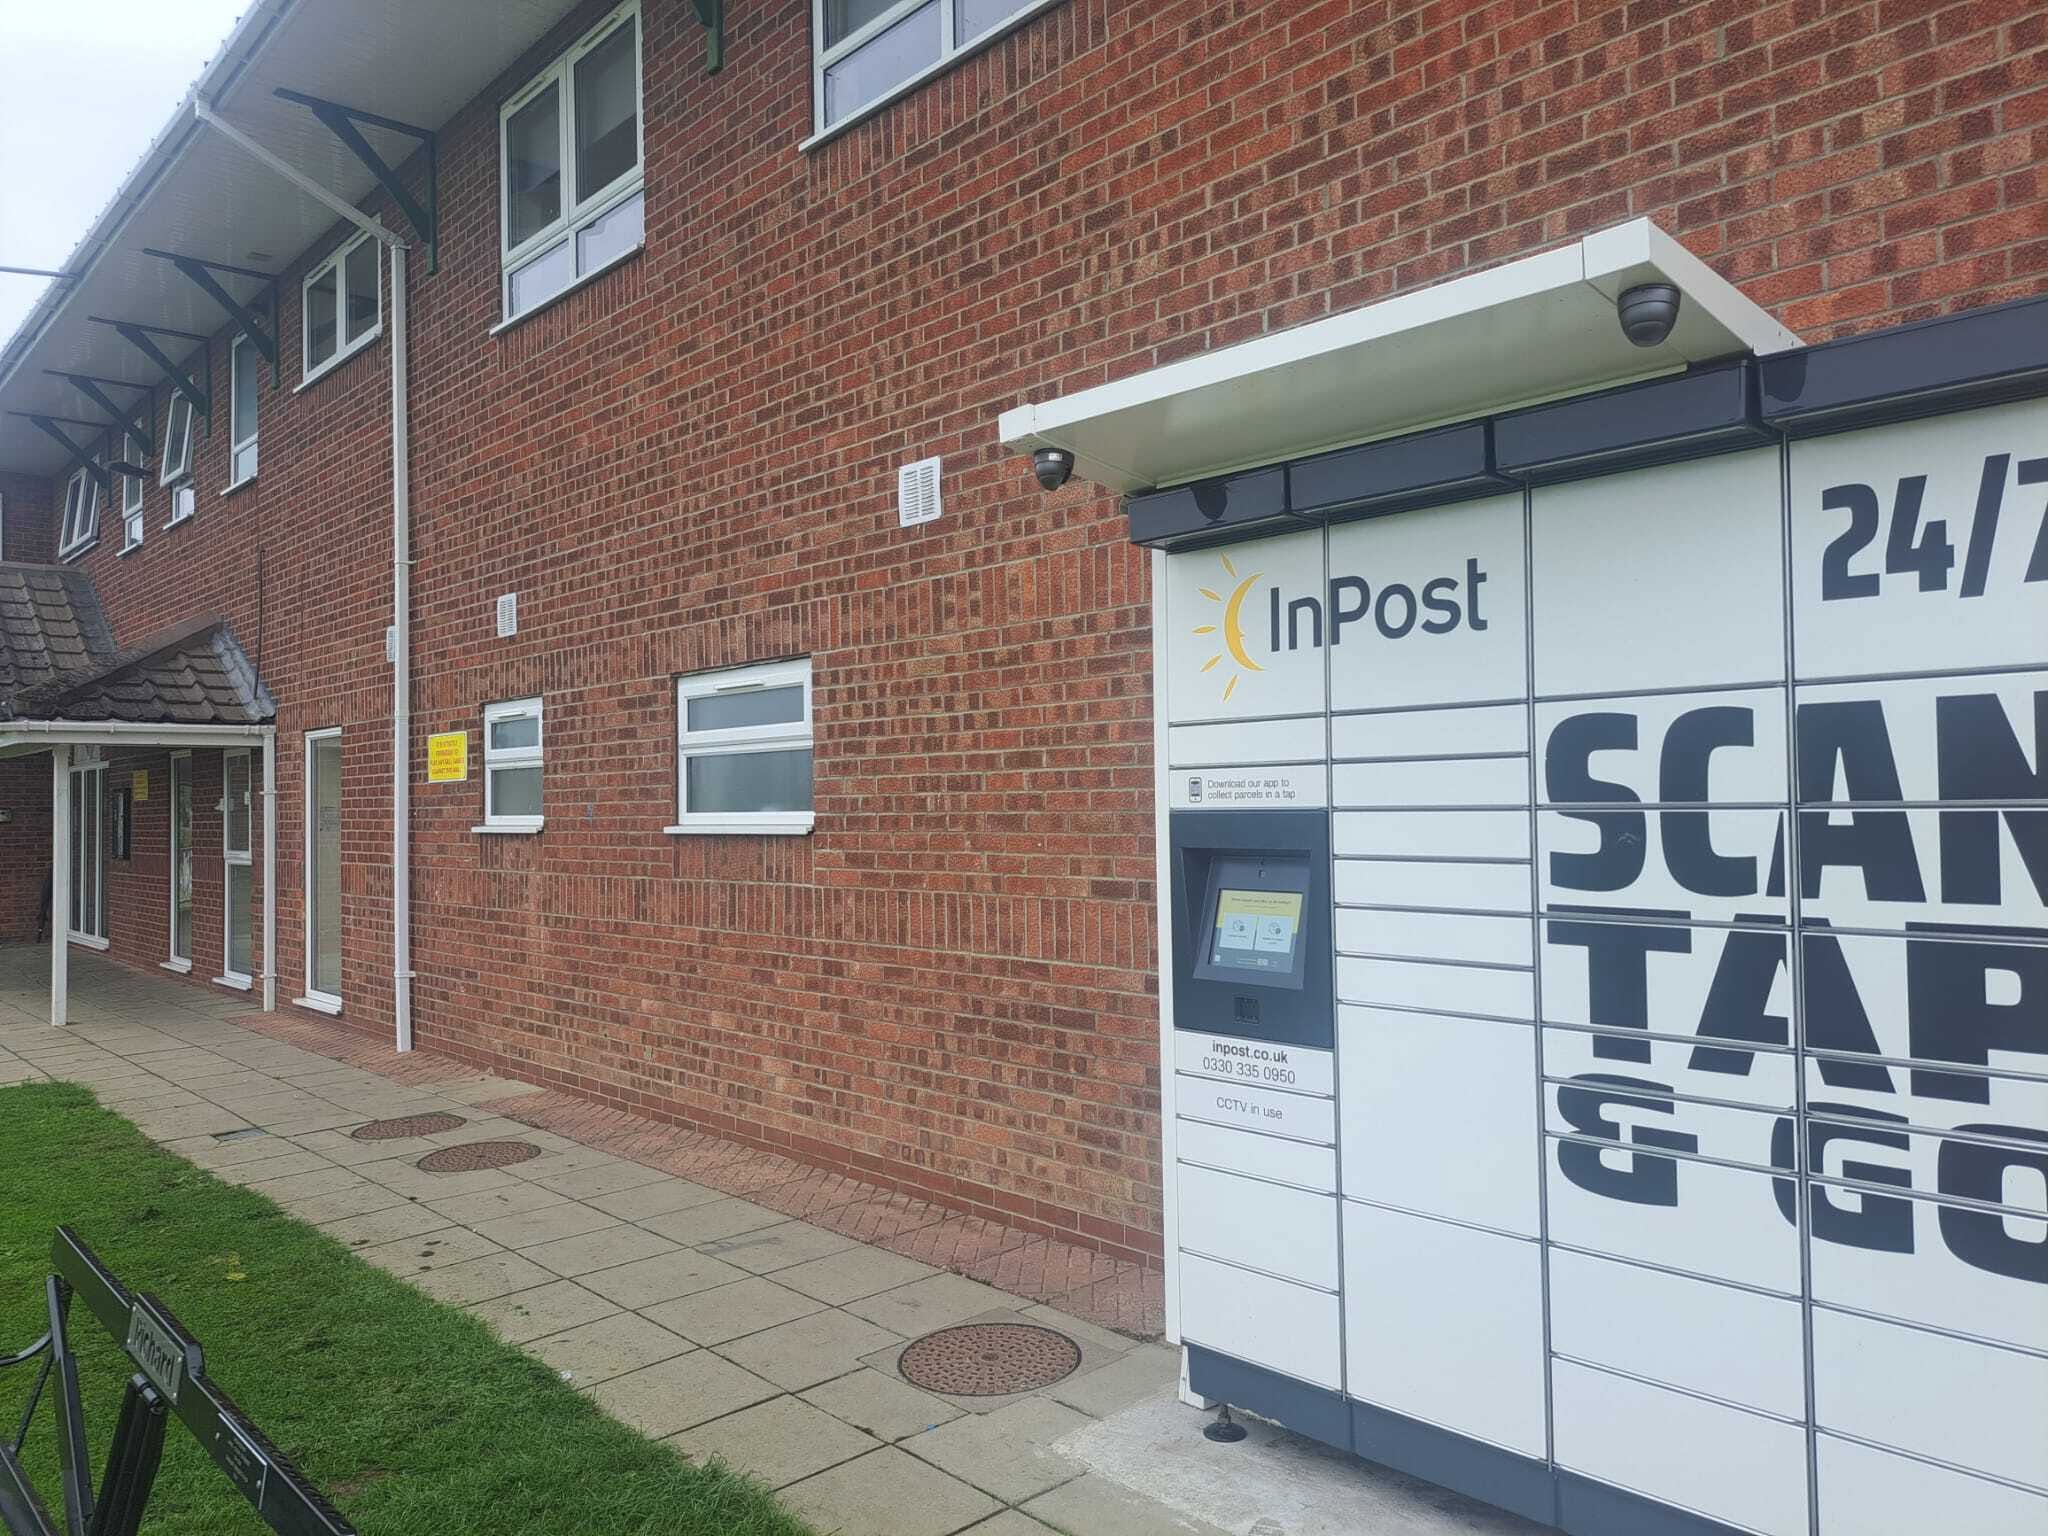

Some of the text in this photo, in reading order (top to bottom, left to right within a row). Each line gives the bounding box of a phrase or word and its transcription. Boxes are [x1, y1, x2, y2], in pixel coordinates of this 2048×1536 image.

[1270, 557, 1488, 653] InPost
[1207, 778, 1290, 789] Download our app to
[1207, 790, 1232, 800] collect
[1234, 790, 1263, 800] parcels
[1265, 790, 1273, 799] in
[1282, 789, 1296, 800] tap
[1545, 690, 2048, 910] SCAN
[1547, 904, 2048, 1110] TAP
[1203, 1056, 1296, 1085] 0330 335 0950
[1212, 1039, 1289, 1064] inpost.co.uk
[1216, 1096, 1283, 1120] CCTV in use
[1557, 1072, 2048, 1284] & GO
[135, 1316, 176, 1387] Richard
